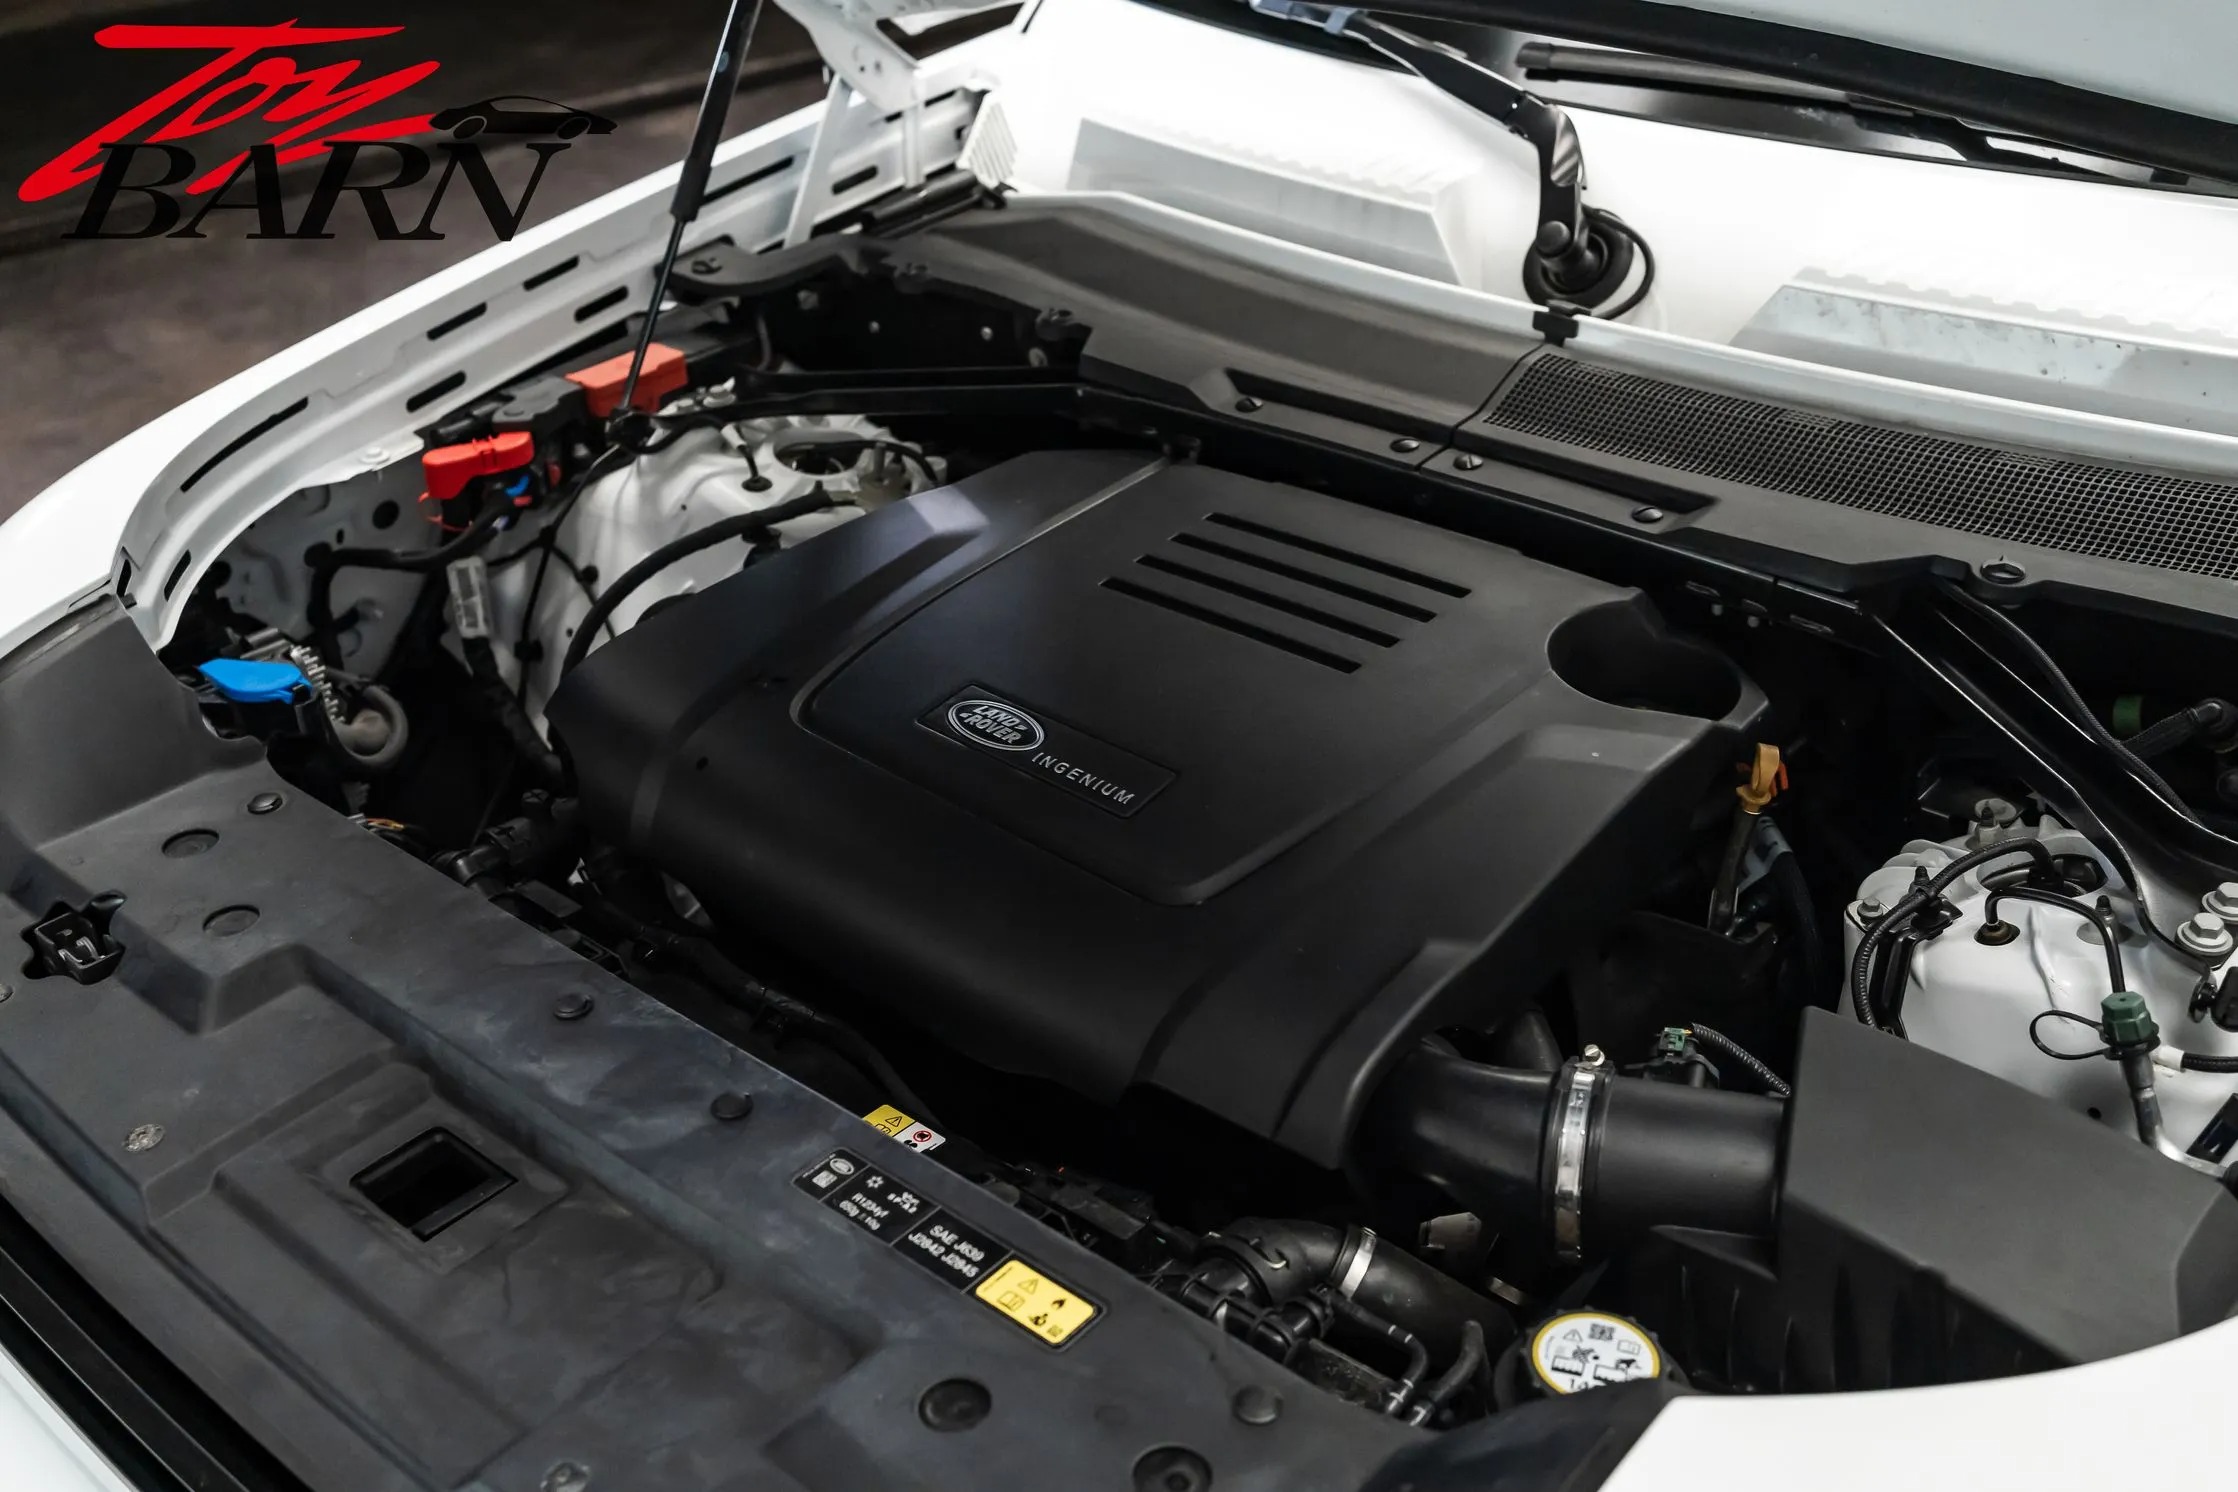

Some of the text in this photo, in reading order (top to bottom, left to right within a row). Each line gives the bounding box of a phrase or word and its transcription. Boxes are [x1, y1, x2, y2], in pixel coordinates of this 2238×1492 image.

[963, 712, 1021, 744] ROVER
[973, 705, 1023, 731] LAND
[1031, 751, 1135, 805] INGENIUM
[929, 1224, 959, 1246] SAE
